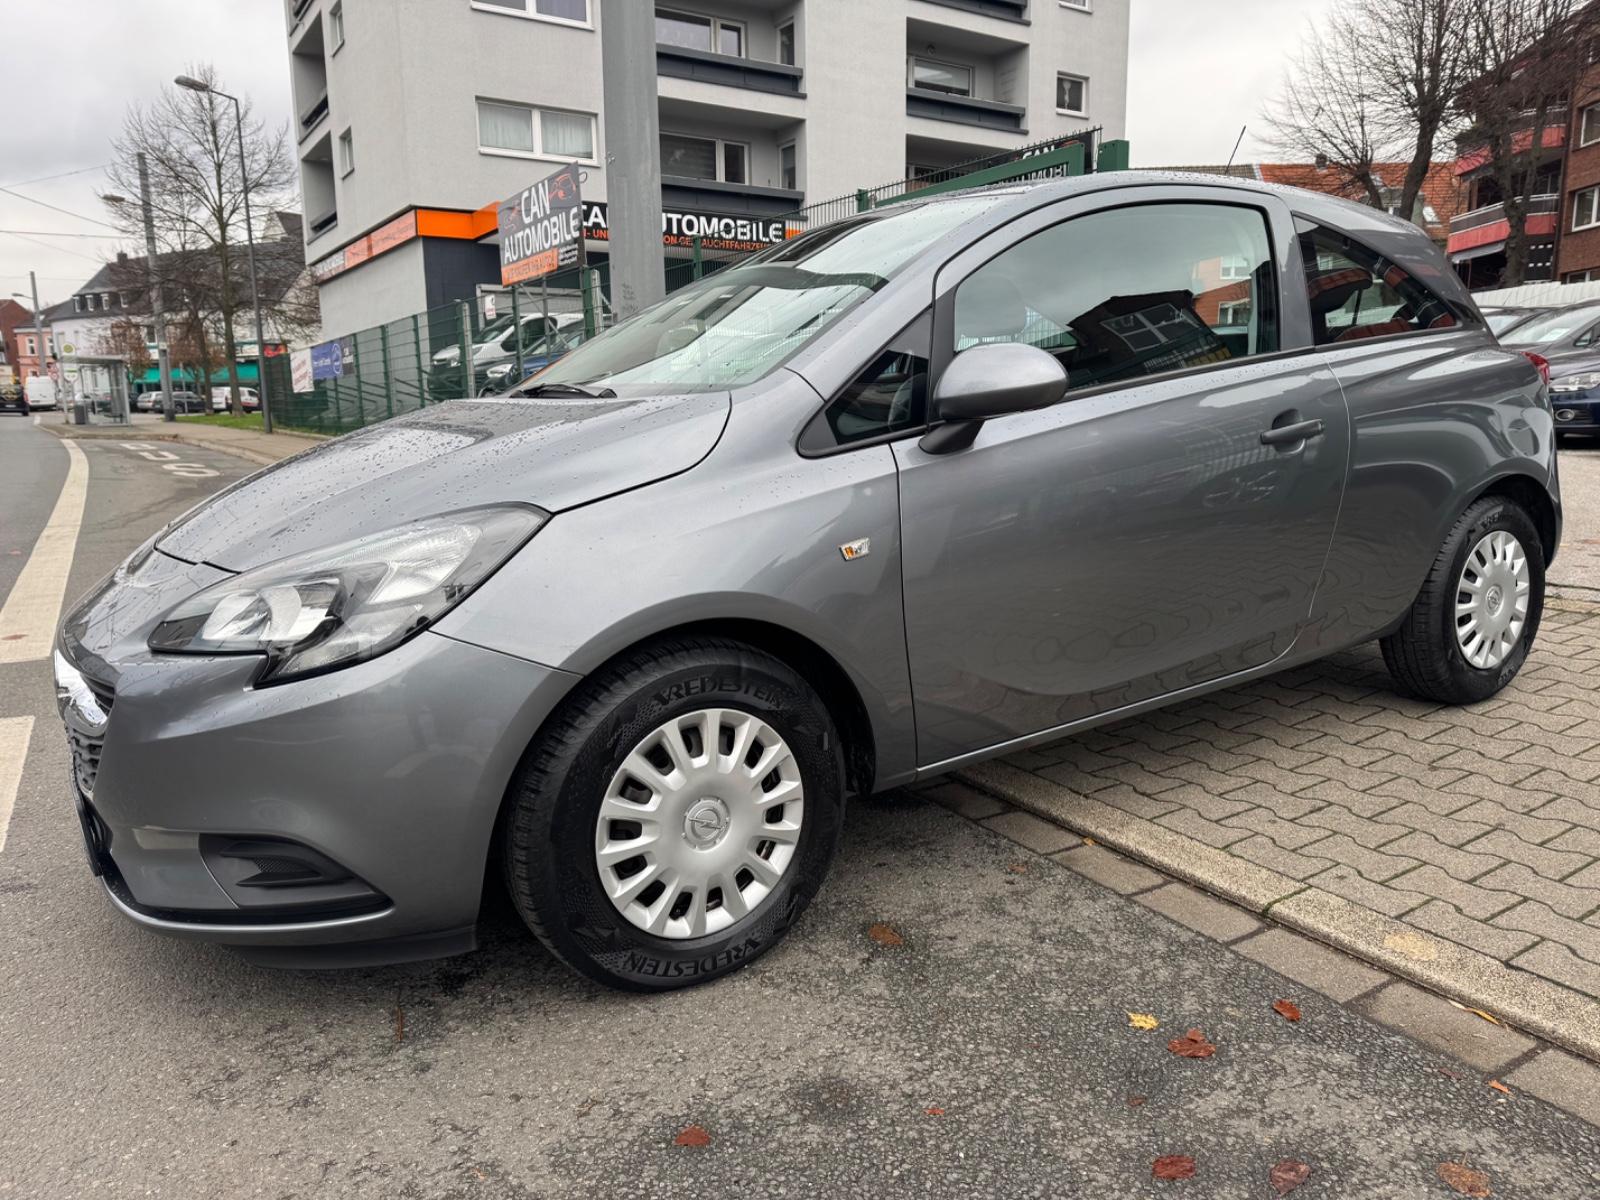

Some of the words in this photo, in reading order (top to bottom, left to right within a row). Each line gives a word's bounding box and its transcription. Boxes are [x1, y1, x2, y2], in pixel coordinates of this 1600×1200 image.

[520, 180, 551, 224] CAN
[504, 206, 581, 264] AUTOMOBILE
[652, 675, 785, 708] VREDESTEIN
[622, 938, 762, 978] VREDESTEIN
